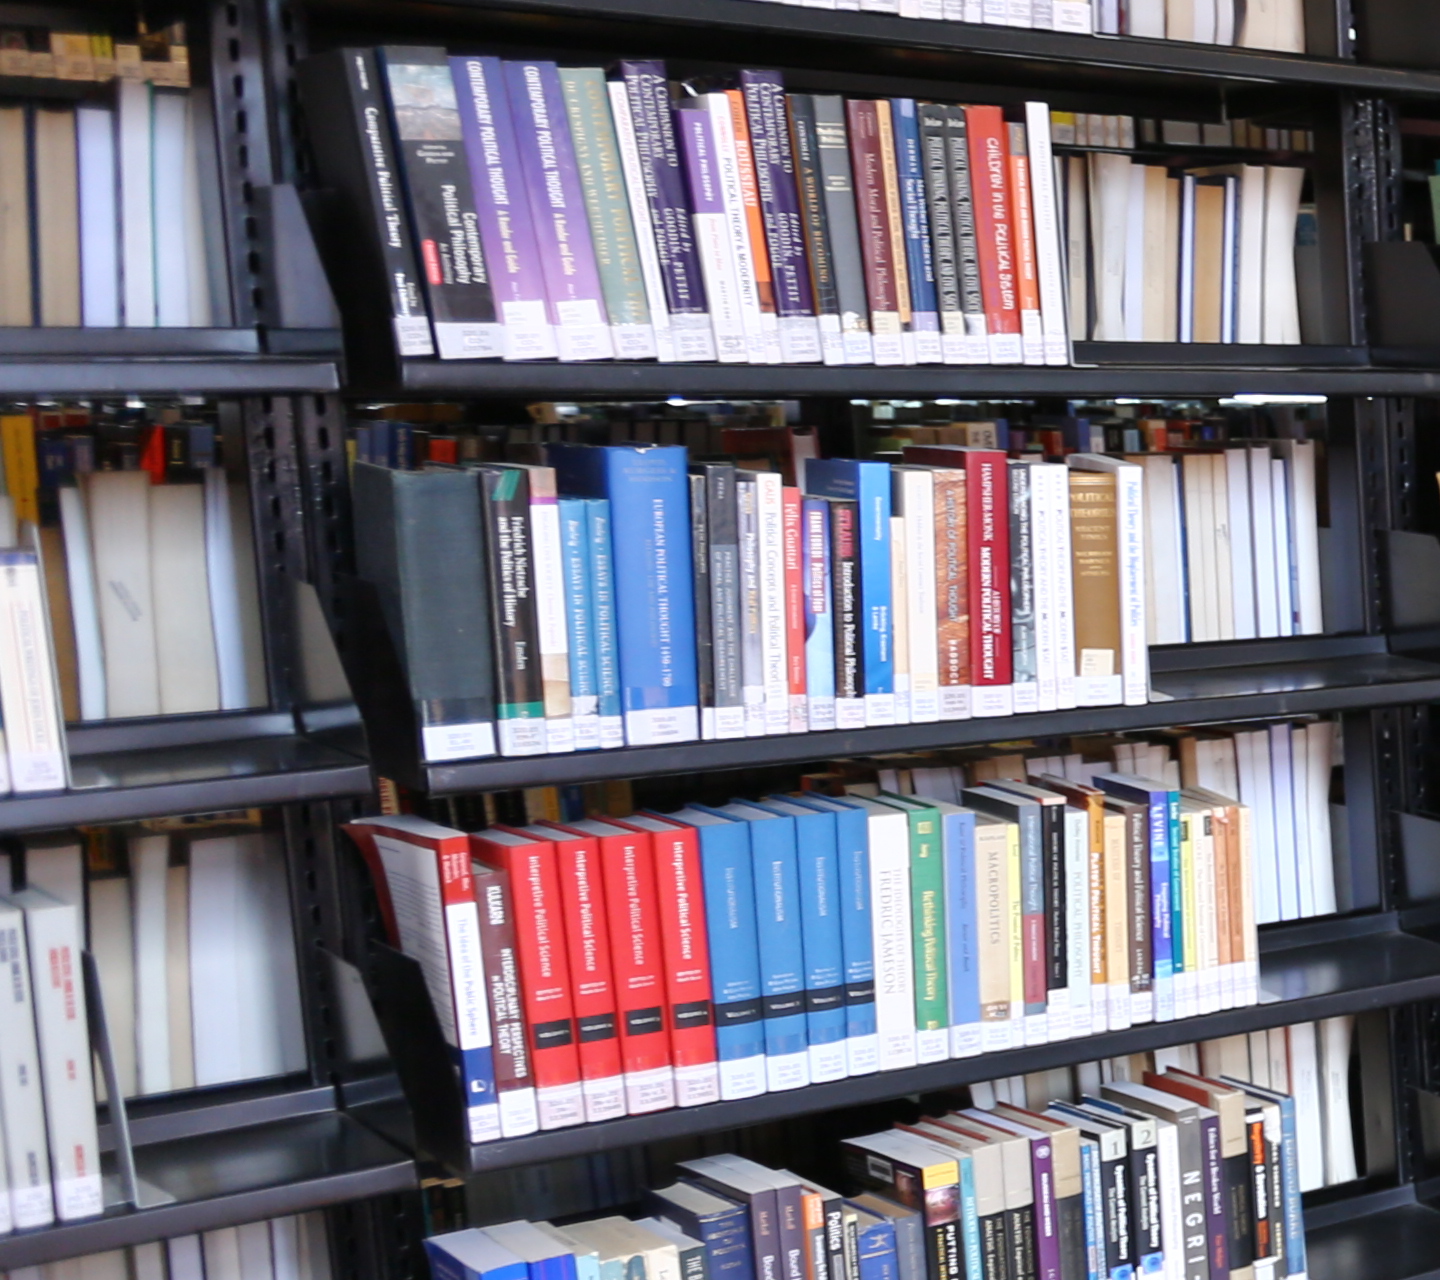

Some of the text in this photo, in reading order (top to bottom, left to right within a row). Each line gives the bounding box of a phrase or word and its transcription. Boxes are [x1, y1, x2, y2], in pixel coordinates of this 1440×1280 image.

[466, 61, 493, 124] CONTEMPORARY
[656, 86, 673, 152] COMPANION
[479, 126, 500, 165] POLITICAL
[523, 66, 566, 208] CONTEMPORARY POLITICAL THOUGHT
[636, 132, 659, 198] PHILOSOPHY
[364, 108, 403, 249] Comparative Political Theory
[488, 167, 509, 206] THOUGHT
[736, 140, 757, 207] ROUSSEAU
[441, 184, 471, 284] Political Philosophy
[462, 212, 486, 284] Contemporary
[723, 158, 737, 203] POLITICAL
[730, 208, 744, 243] THEORY
[738, 254, 753, 306] MODERNITY
[806, 176, 819, 212] WORLD
[813, 231, 828, 282] BECOMING
[652, 499, 665, 544] EUROPEAN
[785, 530, 799, 570] Guattari
[500, 551, 513, 582] Politics
[511, 516, 529, 598] Friedrich Nietzsche
[654, 549, 668, 594] POLITICAL
[843, 562, 855, 612] Introduction
[503, 594, 517, 627] History
[658, 597, 670, 643] THOUGHT
[844, 624, 855, 656] Political
[980, 547, 995, 679] MODERN POLITICAL THOUGHT
[844, 658, 857, 698] Philosoph
[672, 842, 693, 960] Interpretive Political Science
[987, 852, 1000, 945] MACROPOLITICS
[879, 870, 896, 994] FREDRIC JAMESON
[492, 982, 511, 1054] POLITICAL THEORY
[827, 1211, 842, 1251] Politics
[1183, 1170, 1205, 1264] NEGRI
[686, 1256, 701, 1274] THE
